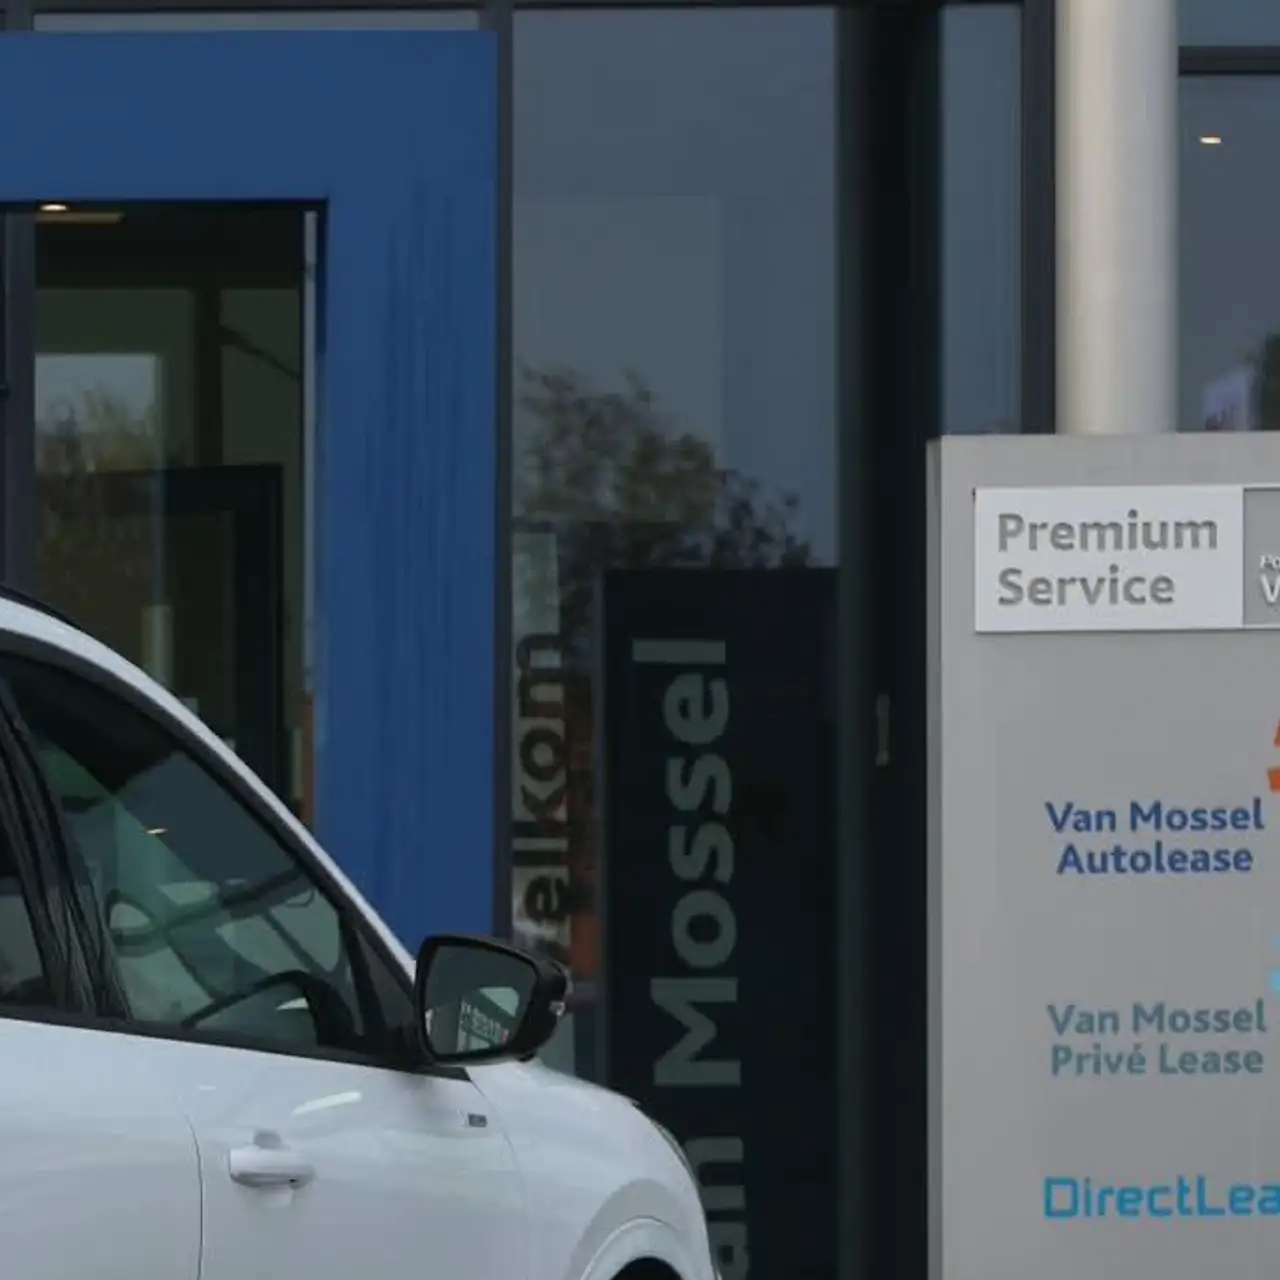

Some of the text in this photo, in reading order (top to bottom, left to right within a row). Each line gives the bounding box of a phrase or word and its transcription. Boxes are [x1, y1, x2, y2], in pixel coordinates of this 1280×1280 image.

[997, 508, 1219, 552] Premium
[997, 564, 1176, 606] Service
[513, 633, 571, 962] elkom
[1044, 797, 1266, 832] Van Mossel
[632, 638, 741, 1086] Mossel
[1056, 843, 1254, 874] Autolease
[1046, 999, 1267, 1035] Van Mossel
[1051, 1042, 1265, 1076] Privé Lease
